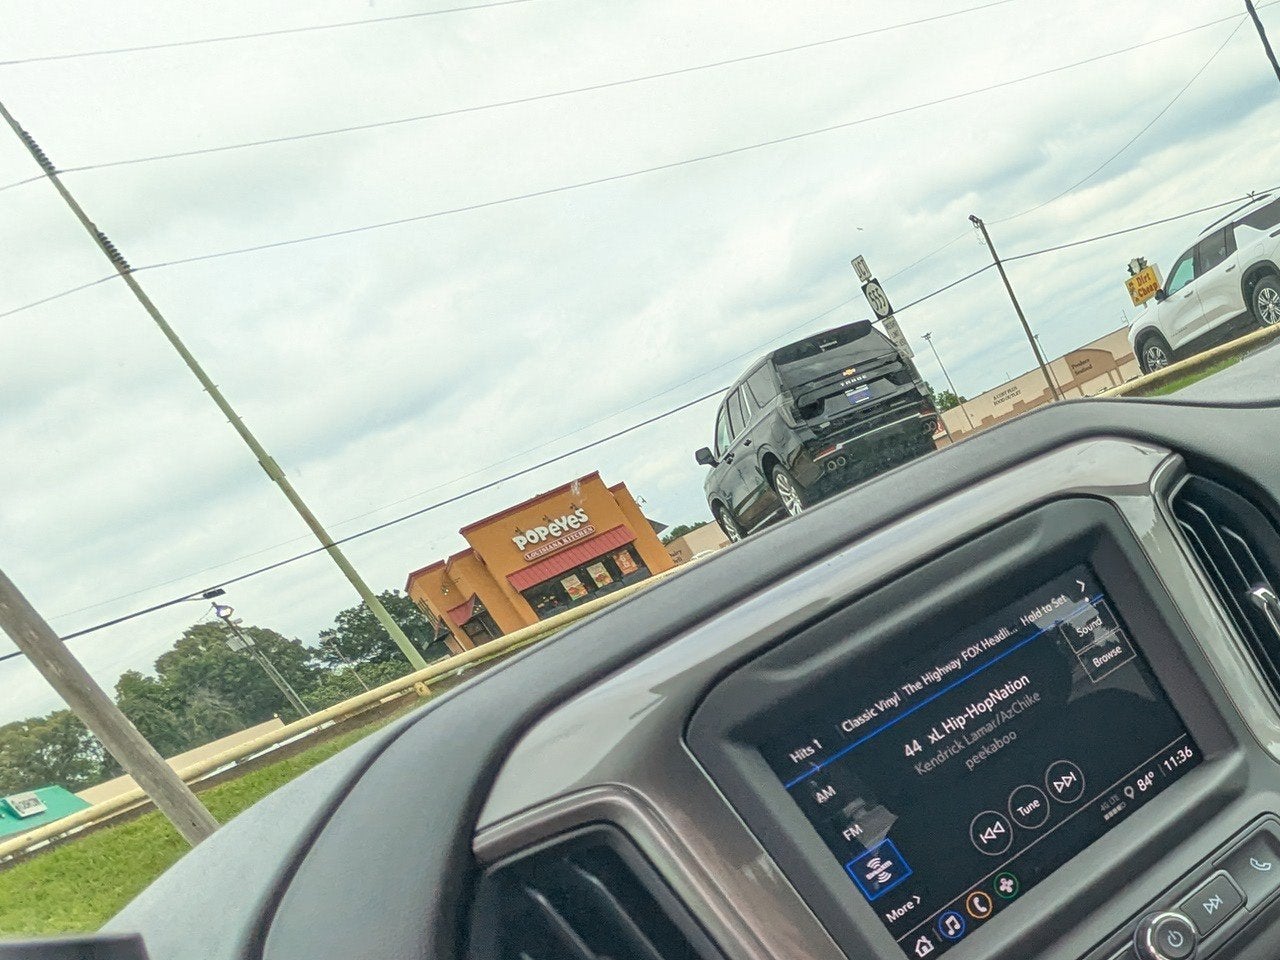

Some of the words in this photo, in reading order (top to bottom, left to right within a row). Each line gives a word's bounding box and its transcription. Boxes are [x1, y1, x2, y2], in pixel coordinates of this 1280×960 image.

[1136, 272, 1151, 287] Dirt
[1138, 282, 1159, 298] Cheap
[1020, 608, 1043, 627] Hold
[1042, 603, 1053, 616] to
[1051, 594, 1068, 610] Set
[1076, 617, 1103, 637] Sound
[961, 642, 983, 662] FOX
[980, 627, 1019, 650] Headli...
[1092, 643, 1123, 668] Browse
[902, 681, 923, 697] The
[921, 659, 962, 686] Highway
[841, 708, 879, 733] Classic
[876, 692, 902, 713] Vinyl
[914, 740, 965, 776] Kendrick
[964, 691, 1042, 746] Lamar/AzChike
[789, 745, 815, 763] Hits
[812, 738, 823, 750] 1
[904, 739, 923, 758] 44
[965, 731, 1018, 771] peekaboo
[1163, 745, 1194, 772] 11:36
[815, 784, 837, 804] AM
[1017, 799, 1041, 817] Tune
[842, 823, 864, 842] FM
[885, 901, 915, 923] More
